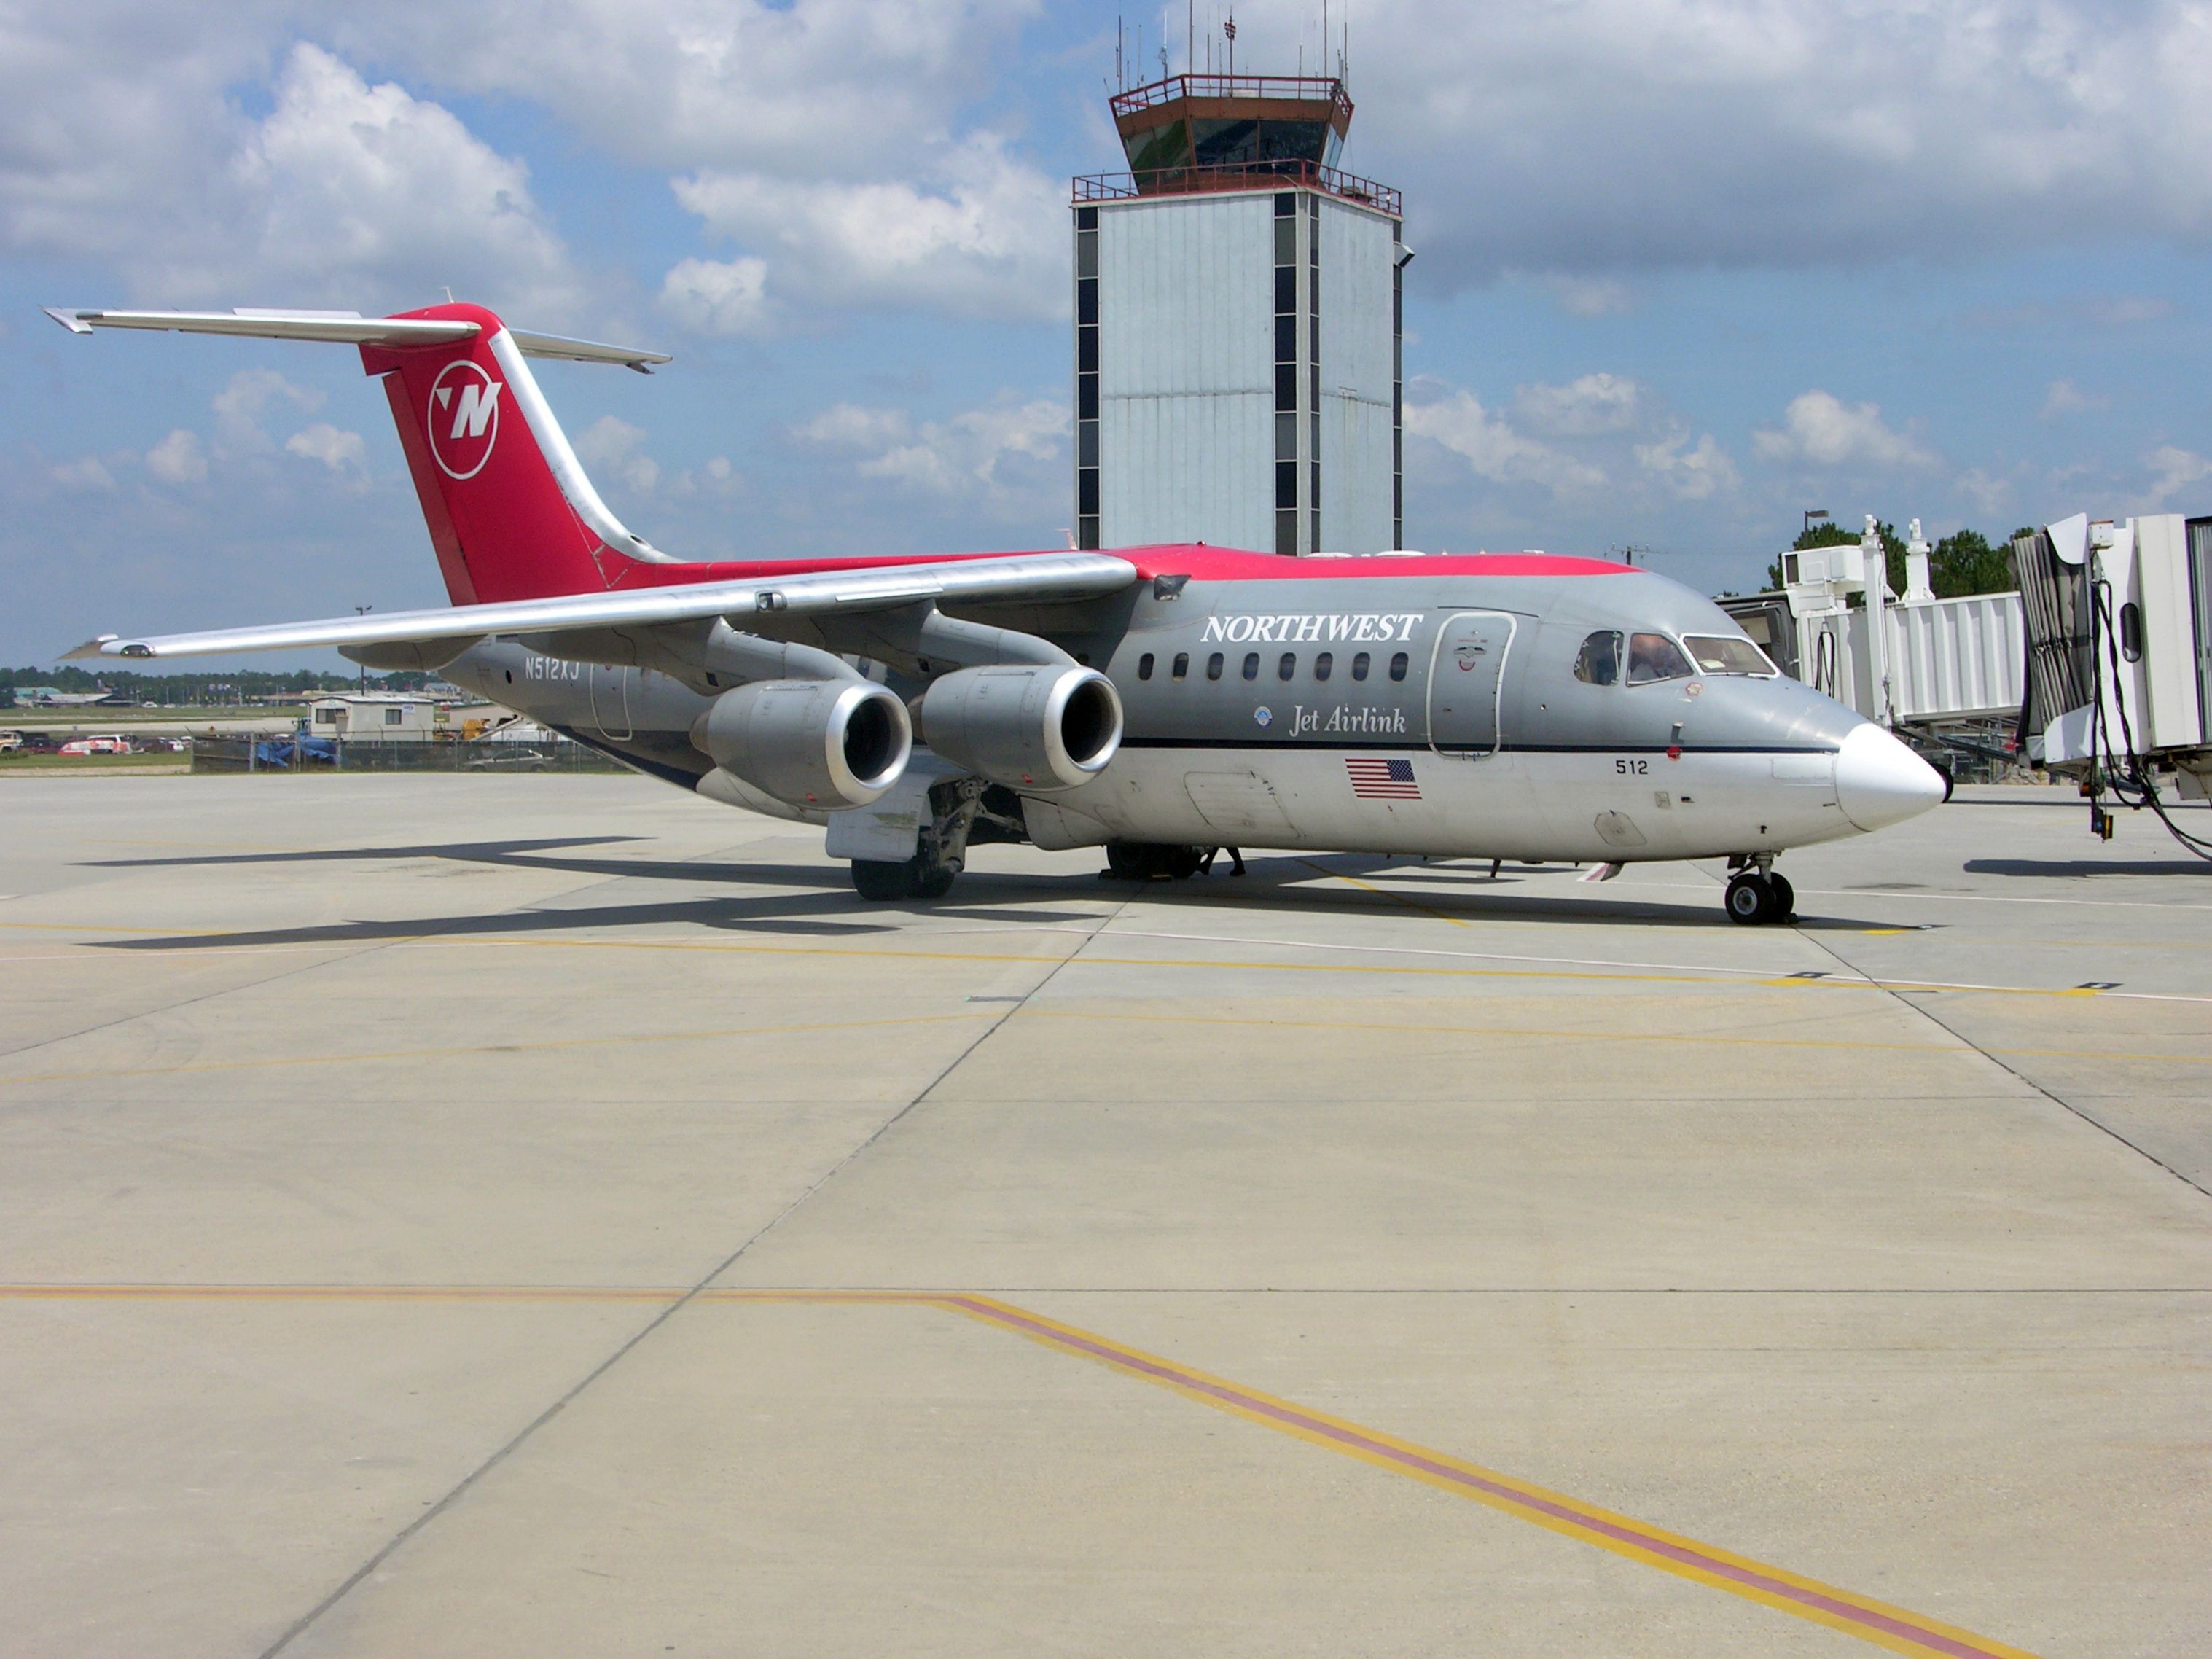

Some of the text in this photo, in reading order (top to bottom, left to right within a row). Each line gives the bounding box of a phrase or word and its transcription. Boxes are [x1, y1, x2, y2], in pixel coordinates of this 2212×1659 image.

[1200, 614, 1425, 642] NORTHWEST
[525, 657, 580, 680] N512XJ
[1289, 706, 1319, 737] Jet
[1324, 705, 1406, 733] Airlink
[1615, 760, 1649, 775] 512
